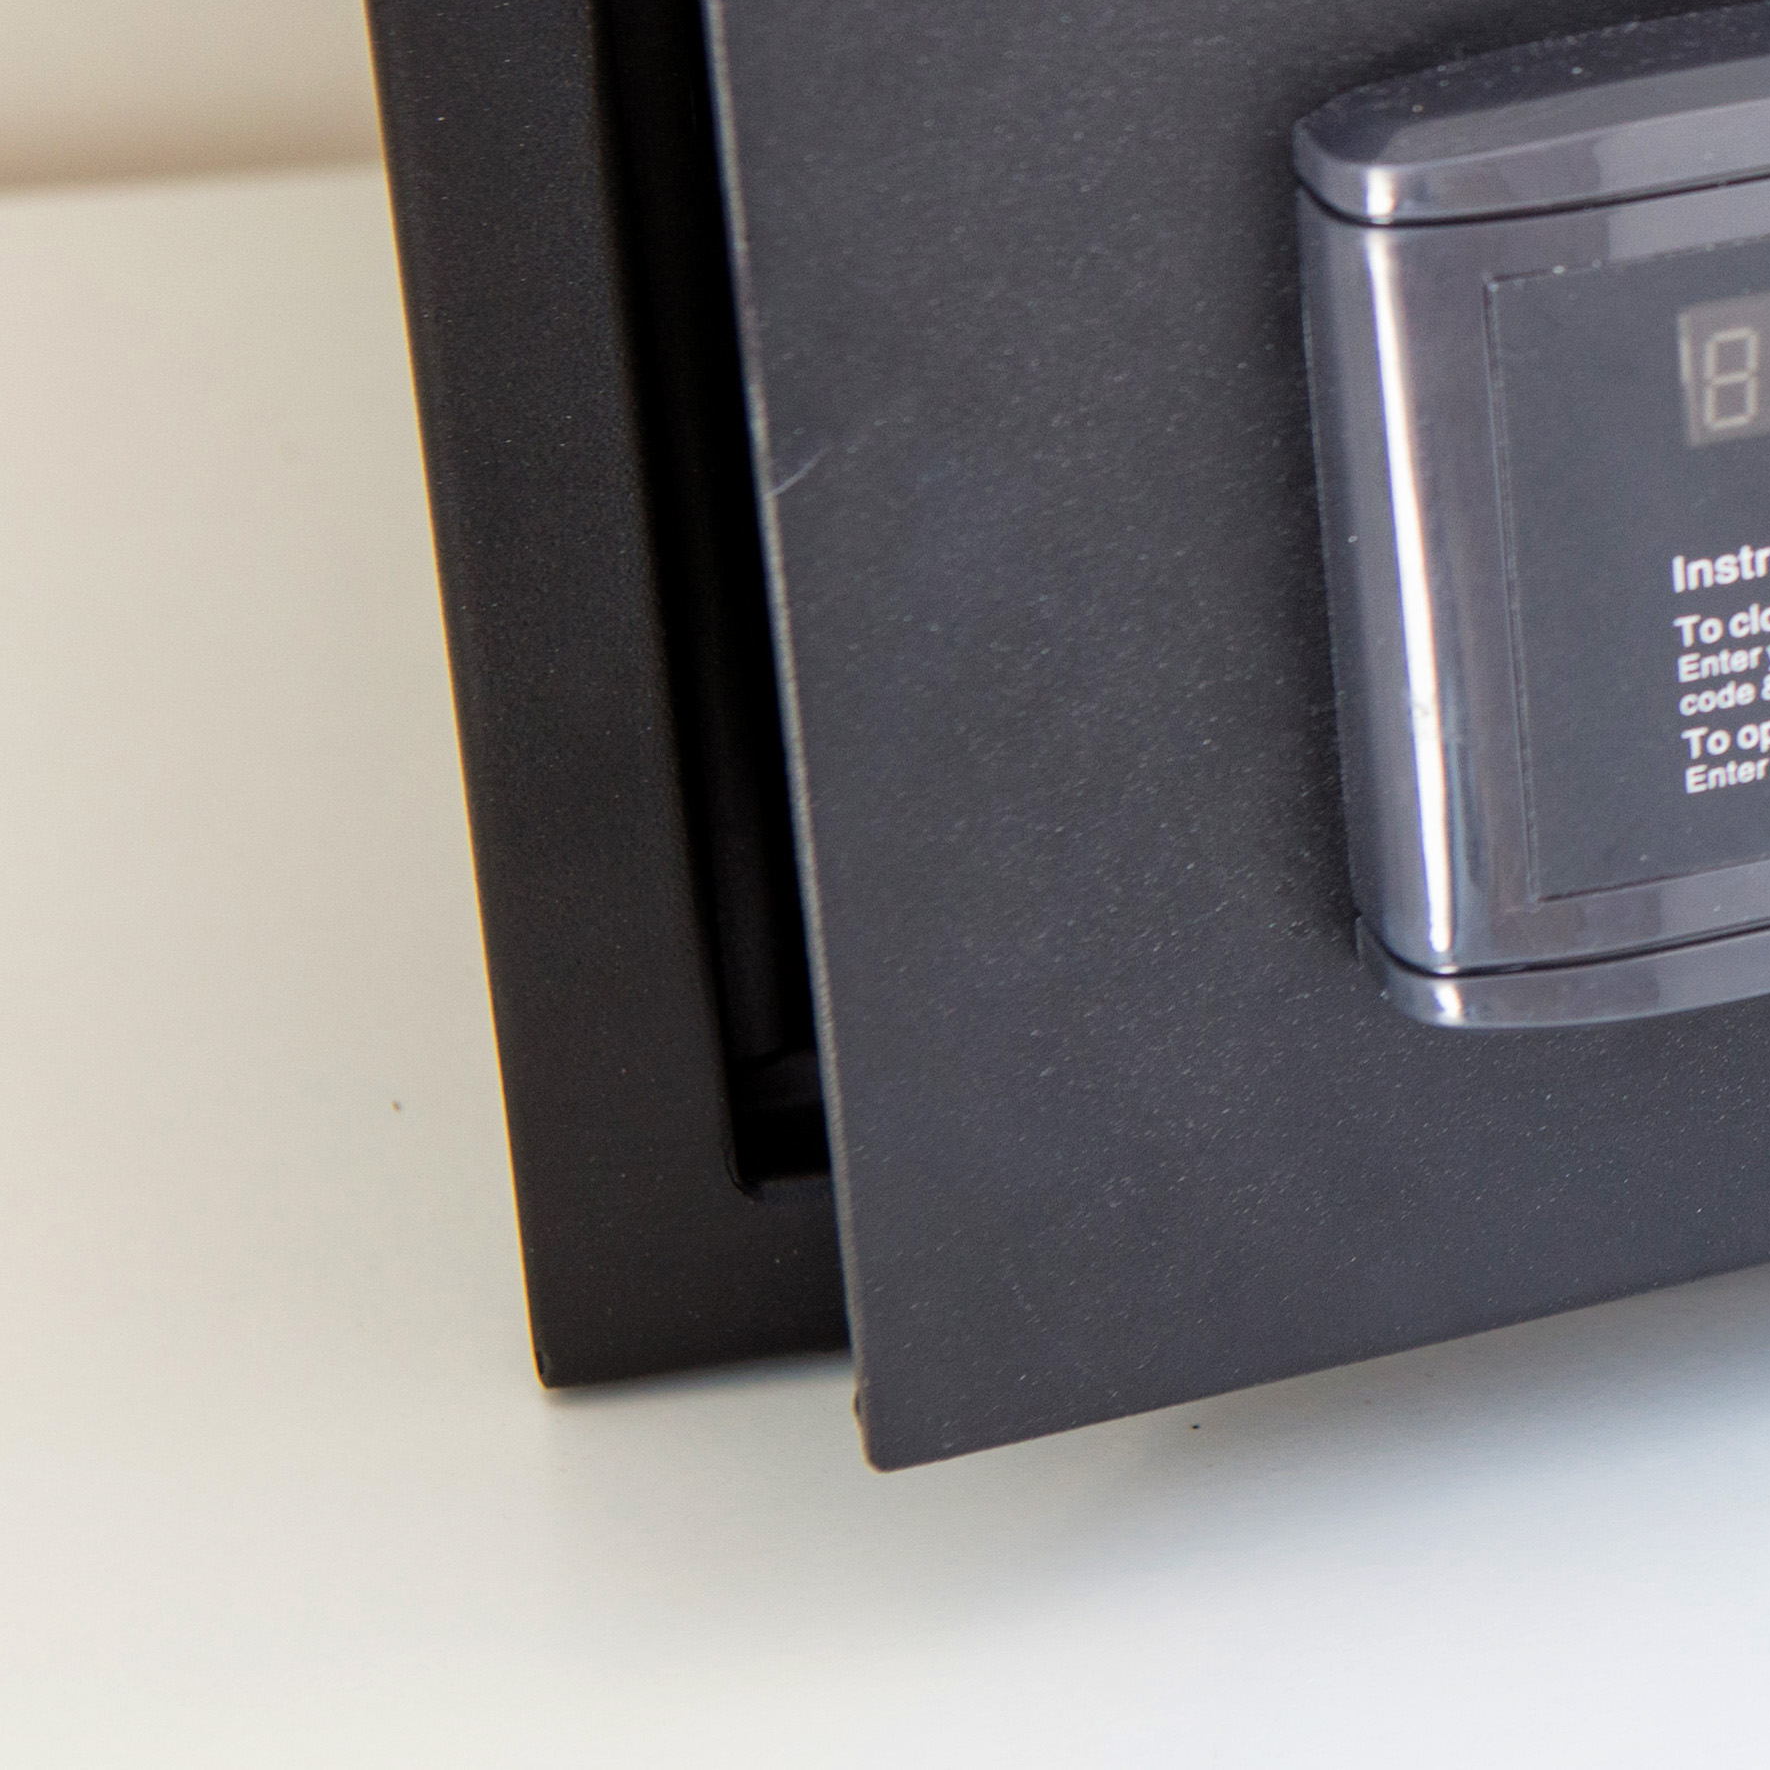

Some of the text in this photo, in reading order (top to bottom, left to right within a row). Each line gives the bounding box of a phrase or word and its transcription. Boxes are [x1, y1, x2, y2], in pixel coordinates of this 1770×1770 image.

[1673, 614, 1724, 648] To
[1677, 646, 1764, 683] Enter
[1679, 680, 1757, 717] code
[1681, 726, 1731, 760] To
[1685, 757, 1770, 794] Enter
